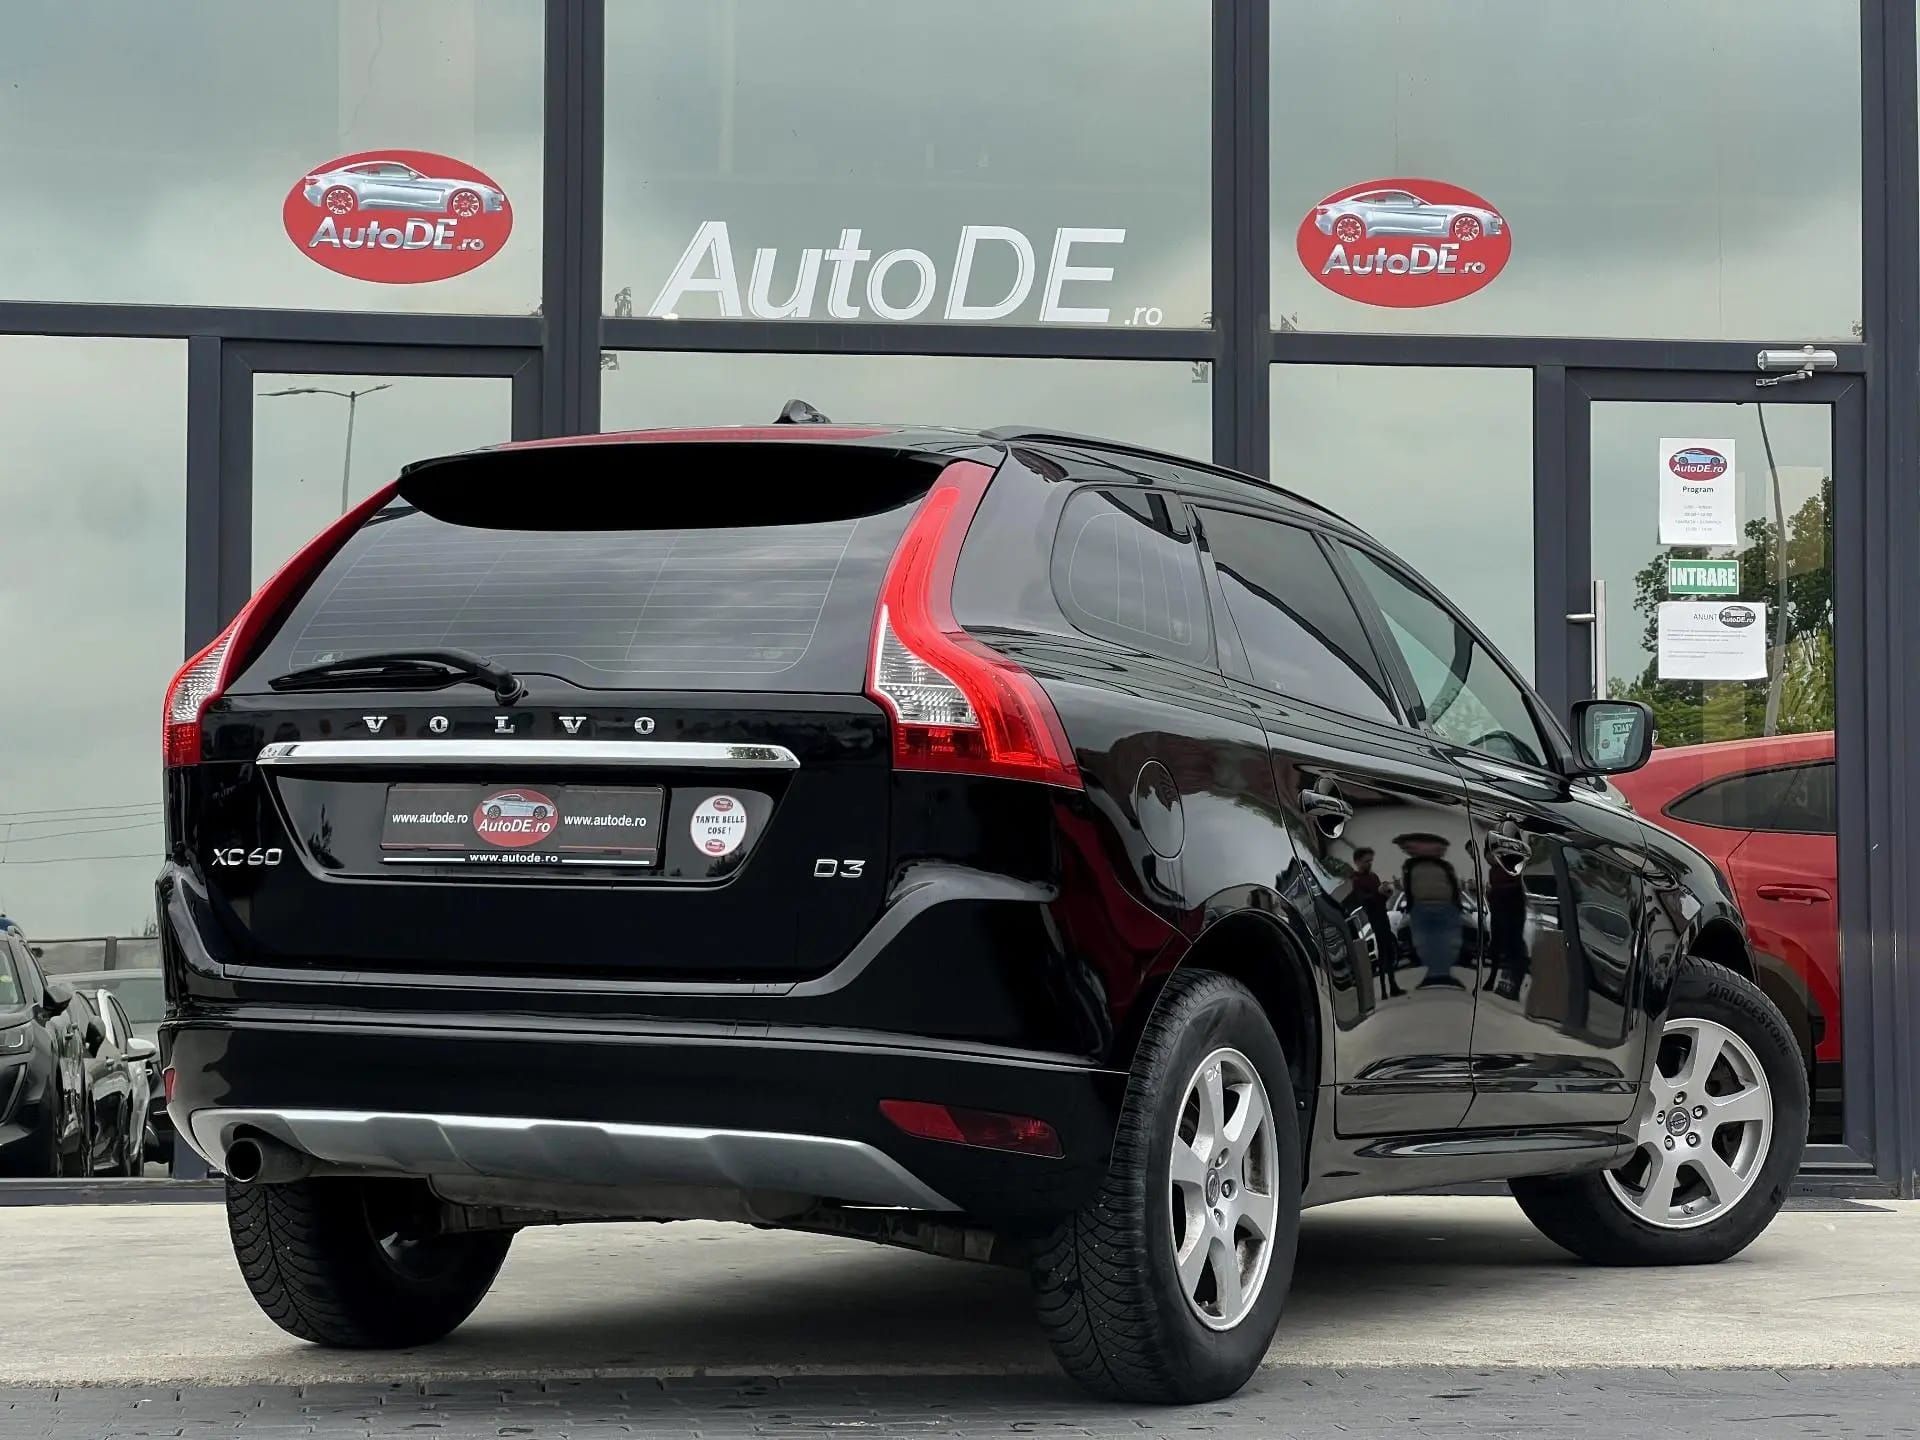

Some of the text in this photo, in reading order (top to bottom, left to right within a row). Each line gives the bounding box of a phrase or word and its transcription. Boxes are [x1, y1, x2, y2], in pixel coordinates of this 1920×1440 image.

[308, 216, 485, 251] AutoDE.ro
[1321, 243, 1486, 275] AutoDE.ro
[1673, 464, 1724, 473] AutoDE.ro
[1682, 486, 1714, 494] Program
[1671, 567, 1736, 587] INTRARE
[362, 716, 656, 735] VOLVO
[392, 812, 469, 824] www.autode.ro
[564, 814, 647, 827] www.autode.ro
[696, 815, 745, 824] TANTE BELLE
[477, 819, 551, 833] AutoDE.ro
[707, 826, 726, 835] COSE
[211, 847, 283, 866] XC60
[469, 853, 558, 863] www.autode.ro
[814, 858, 866, 878] D3
